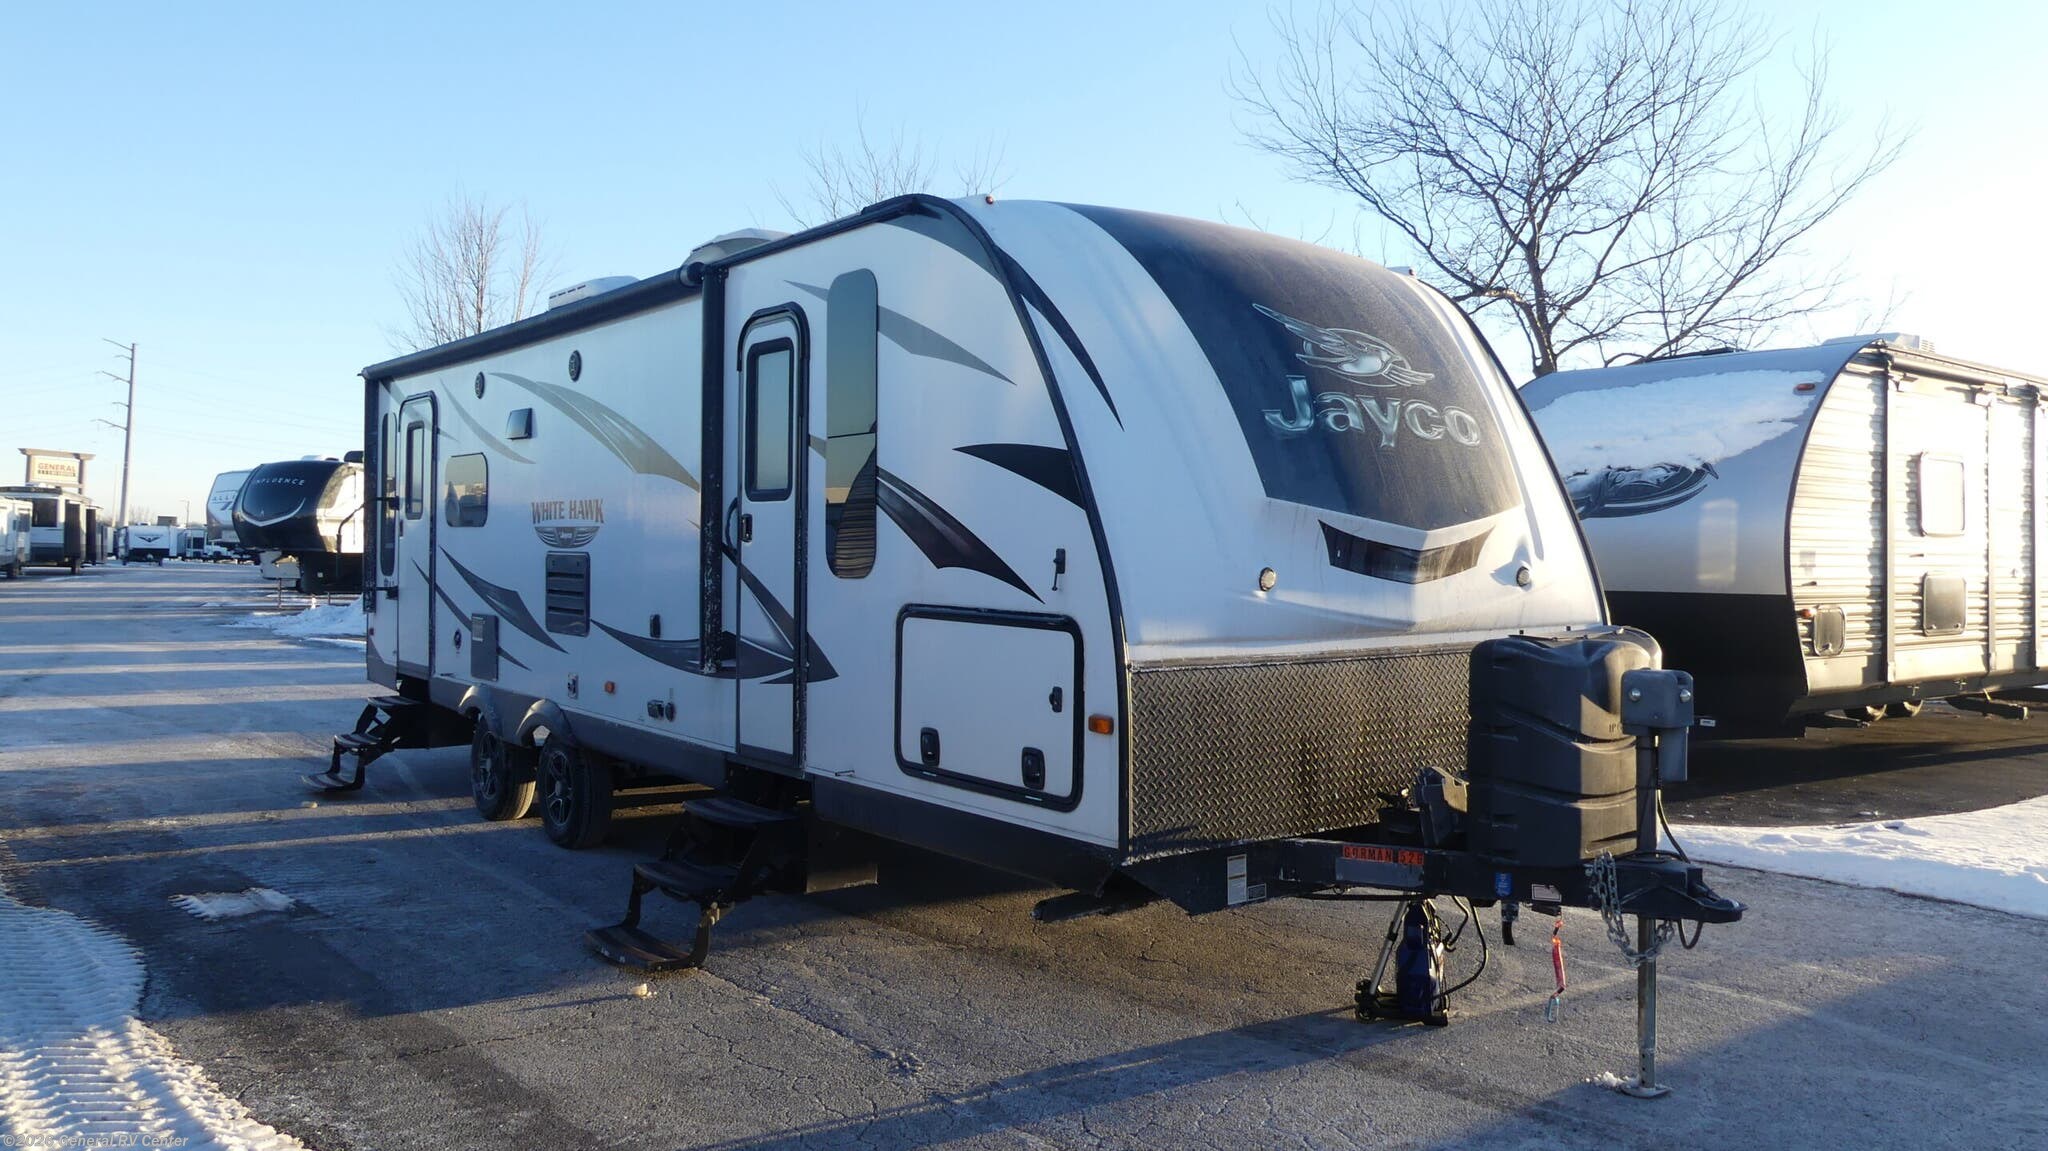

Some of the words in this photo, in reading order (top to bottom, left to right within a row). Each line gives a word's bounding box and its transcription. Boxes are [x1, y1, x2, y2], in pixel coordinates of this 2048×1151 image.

[1262, 374, 1480, 448] Jayco
[38, 462, 76, 472] GENERAL
[531, 501, 565, 524] WHITE
[568, 499, 605, 524] HAWK
